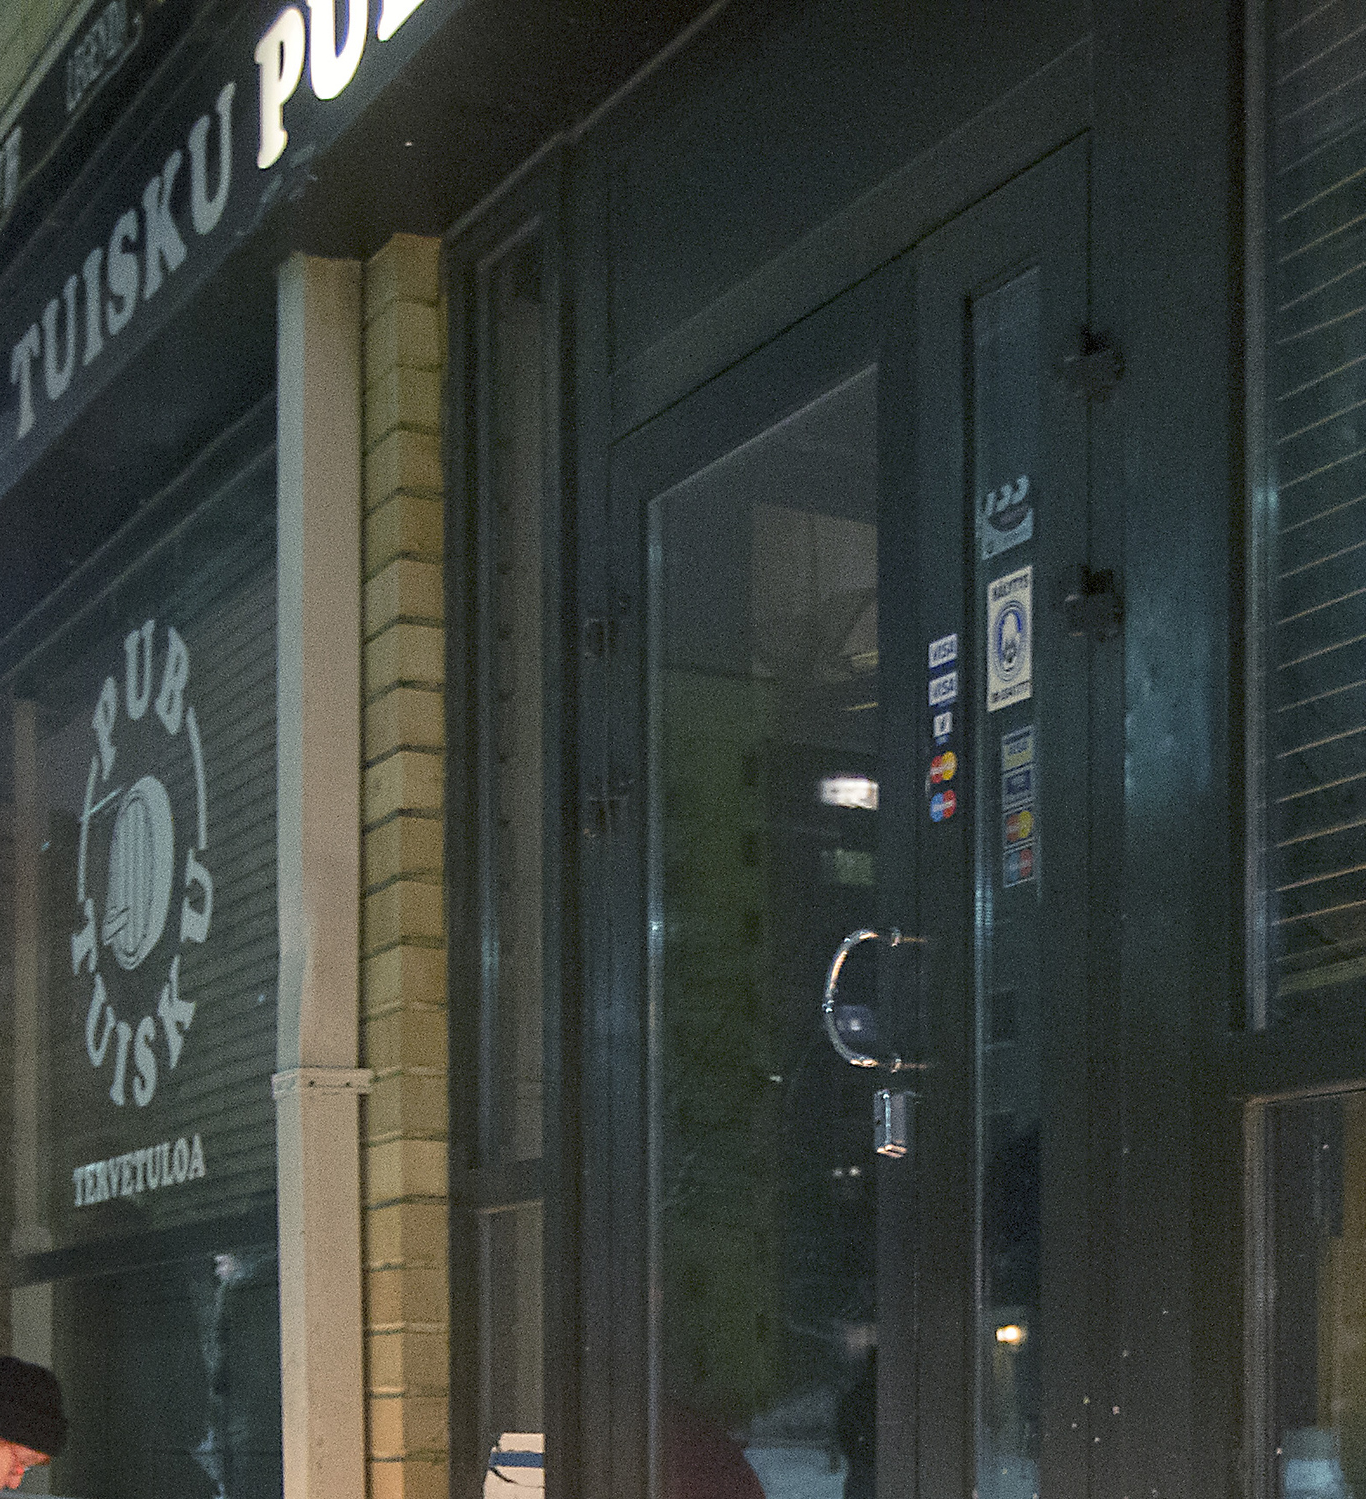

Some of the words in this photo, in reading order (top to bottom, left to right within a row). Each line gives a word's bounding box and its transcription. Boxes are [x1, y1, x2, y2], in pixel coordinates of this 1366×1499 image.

[11, 82, 235, 438] TUISKU
[92, 620, 190, 781] PUB
[74, 1133, 206, 1207] TERVETULOA
